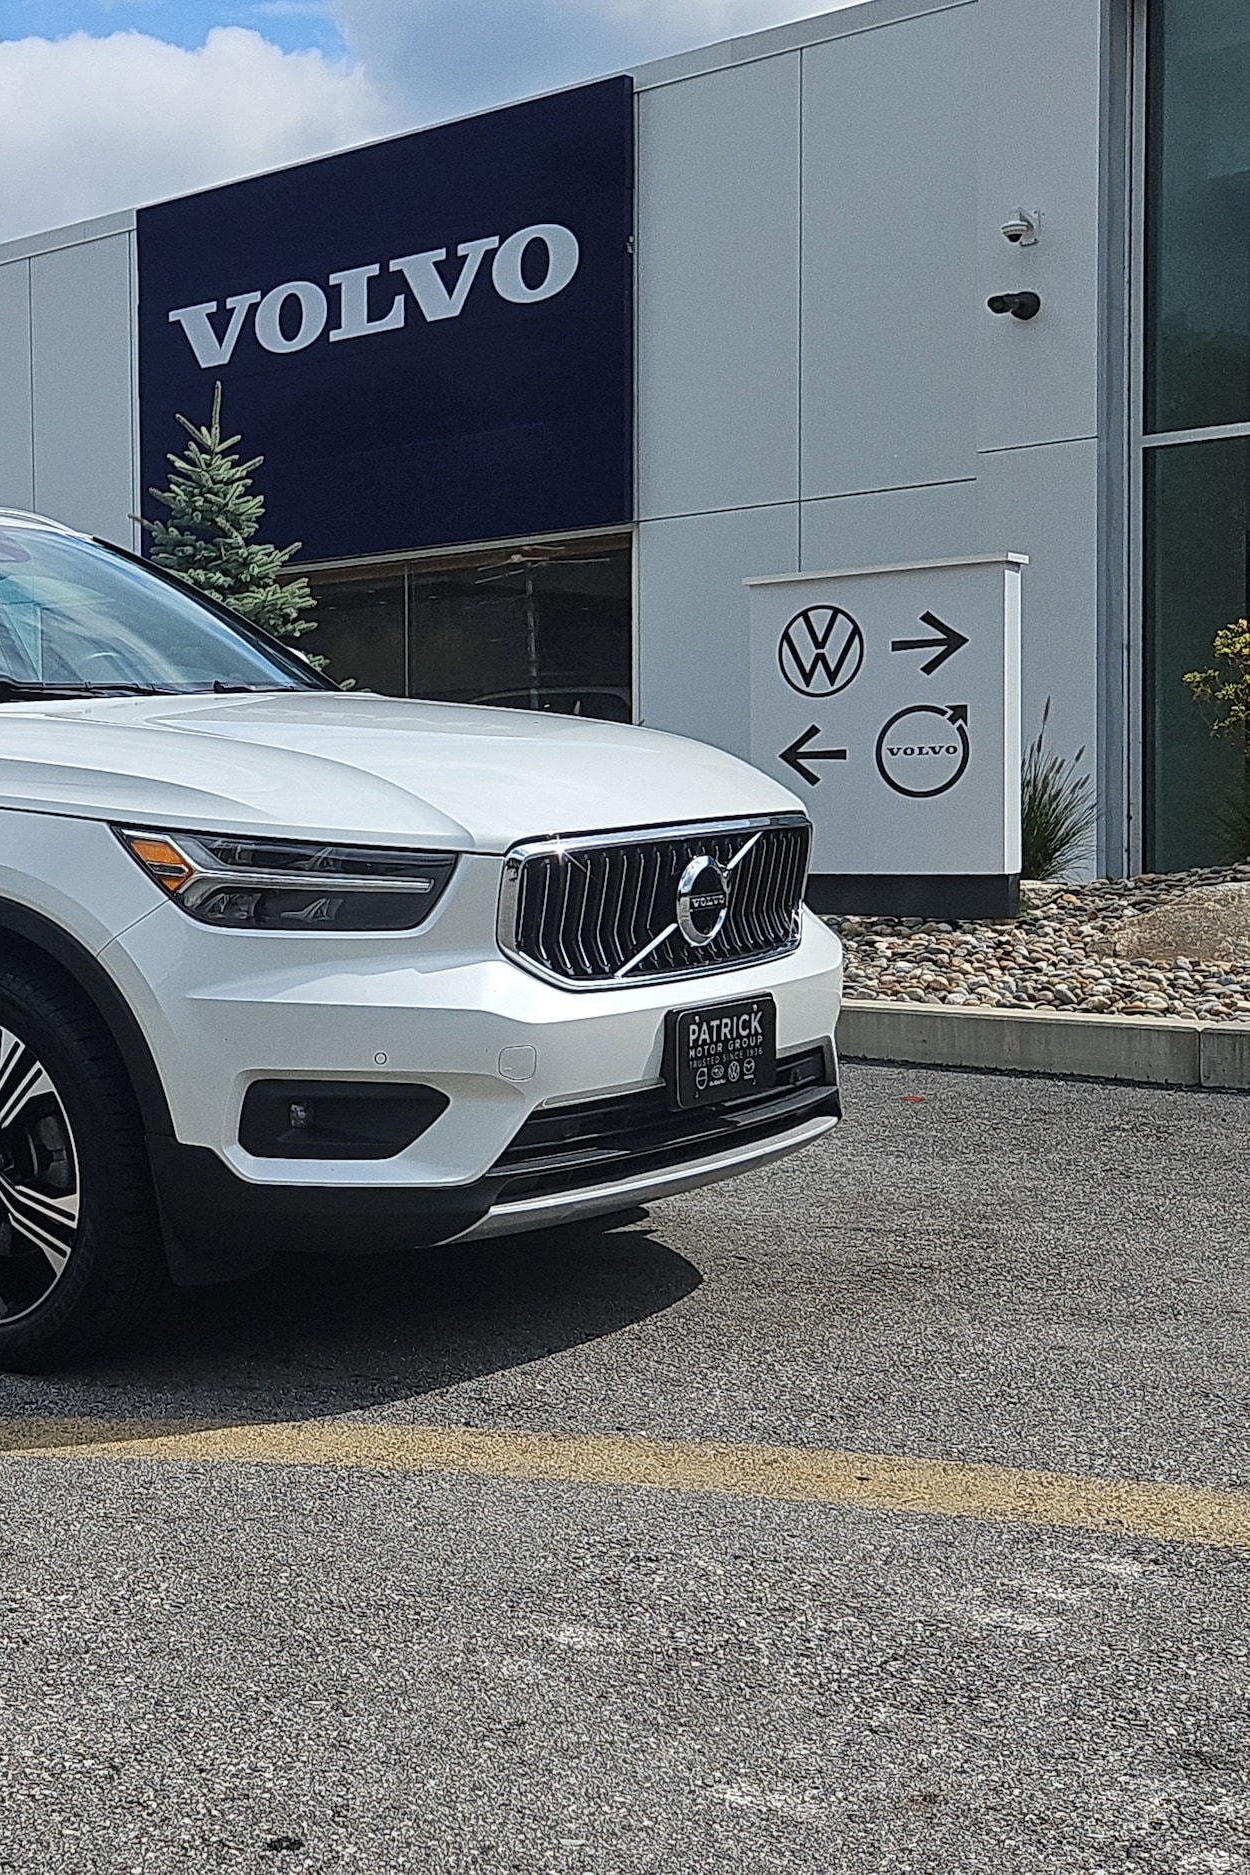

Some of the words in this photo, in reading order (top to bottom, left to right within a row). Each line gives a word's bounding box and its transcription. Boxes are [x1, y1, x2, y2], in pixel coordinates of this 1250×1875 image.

[168, 224, 579, 368] VOLVO
[886, 745, 958, 757] VOLVO
[691, 895, 725, 907] VOLVO
[689, 1011, 763, 1047] PATRICK
[689, 1042, 723, 1059] MOTOR
[727, 1035, 763, 1051] GROUP
[689, 1055, 721, 1069] TRUSTED
[722, 1050, 744, 1062] SINCE
